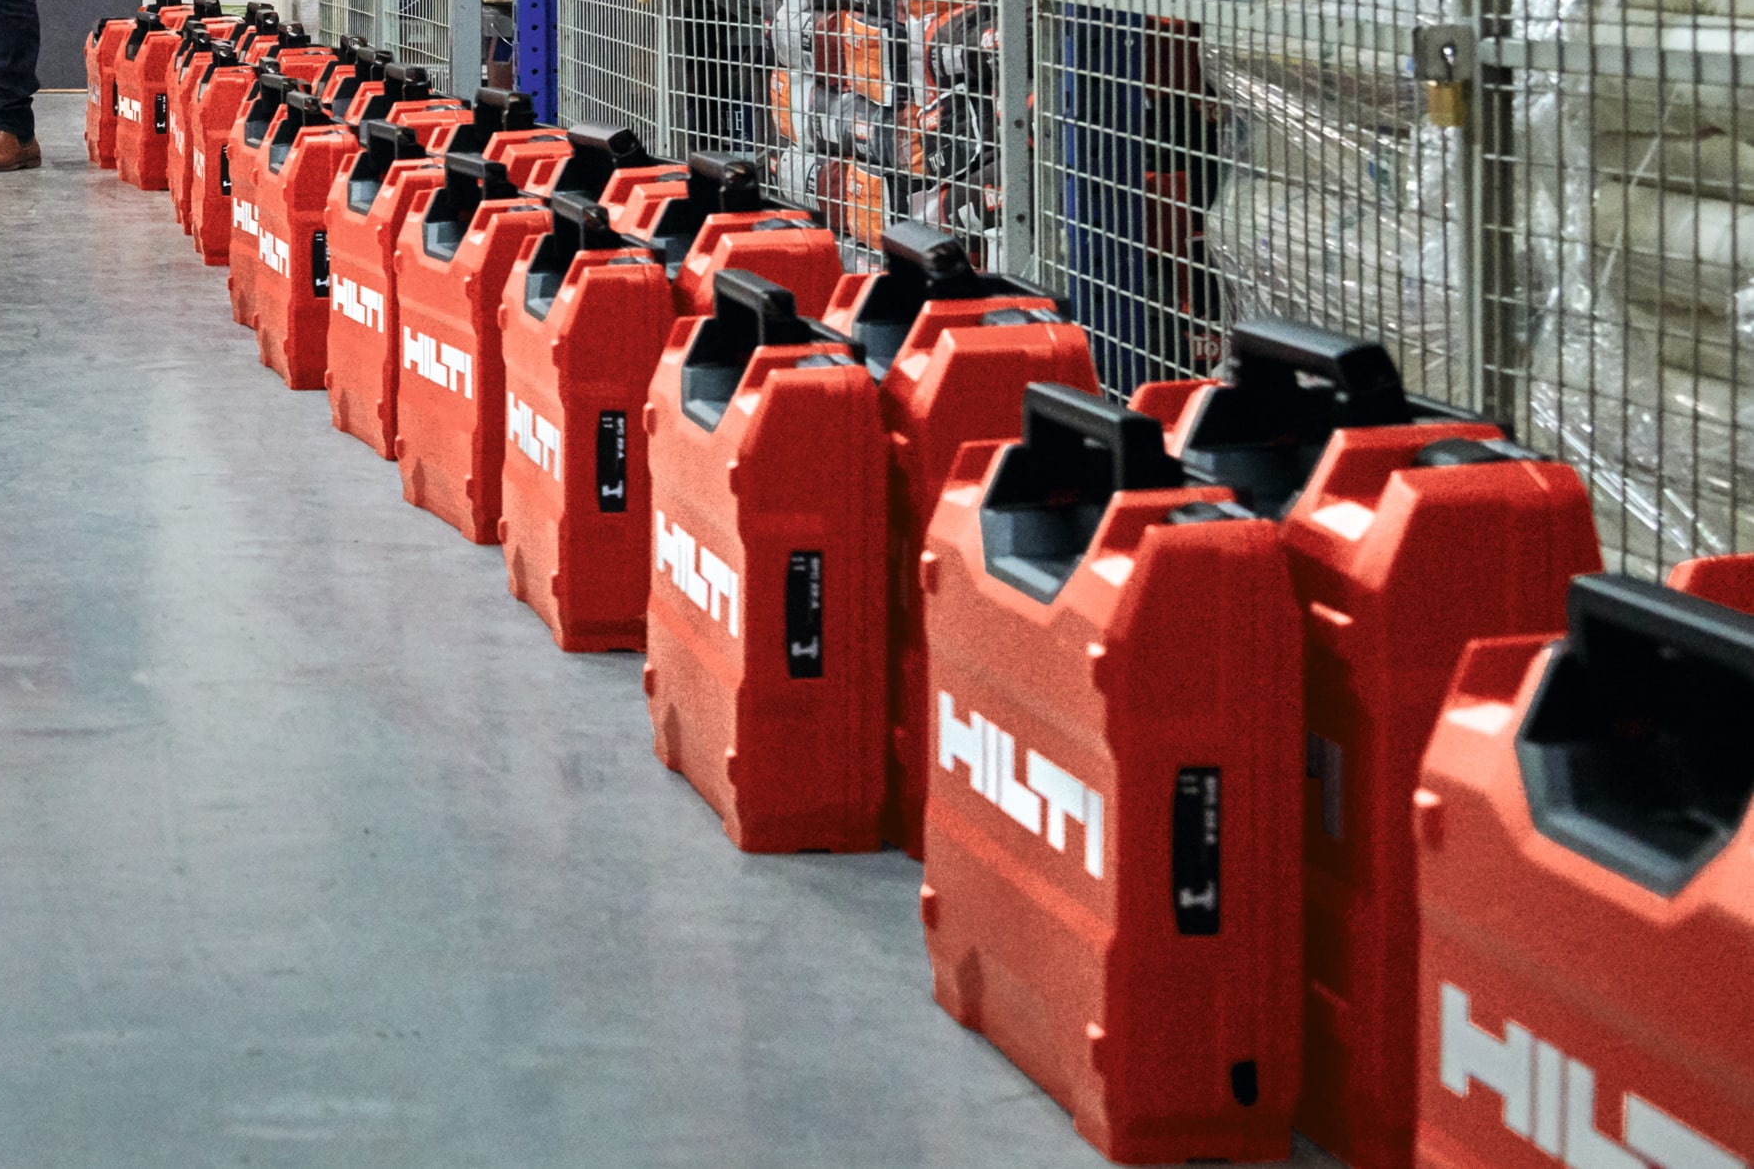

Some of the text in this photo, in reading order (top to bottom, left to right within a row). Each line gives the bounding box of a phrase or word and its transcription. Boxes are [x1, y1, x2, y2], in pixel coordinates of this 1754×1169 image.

[118, 95, 142, 124] HILTI
[258, 227, 291, 279] HILTI
[332, 273, 384, 334] HILTI
[403, 325, 473, 400] HILTI
[508, 391, 562, 484] HILTI
[656, 510, 739, 639] HILTI
[938, 689, 1103, 881] HILTI
